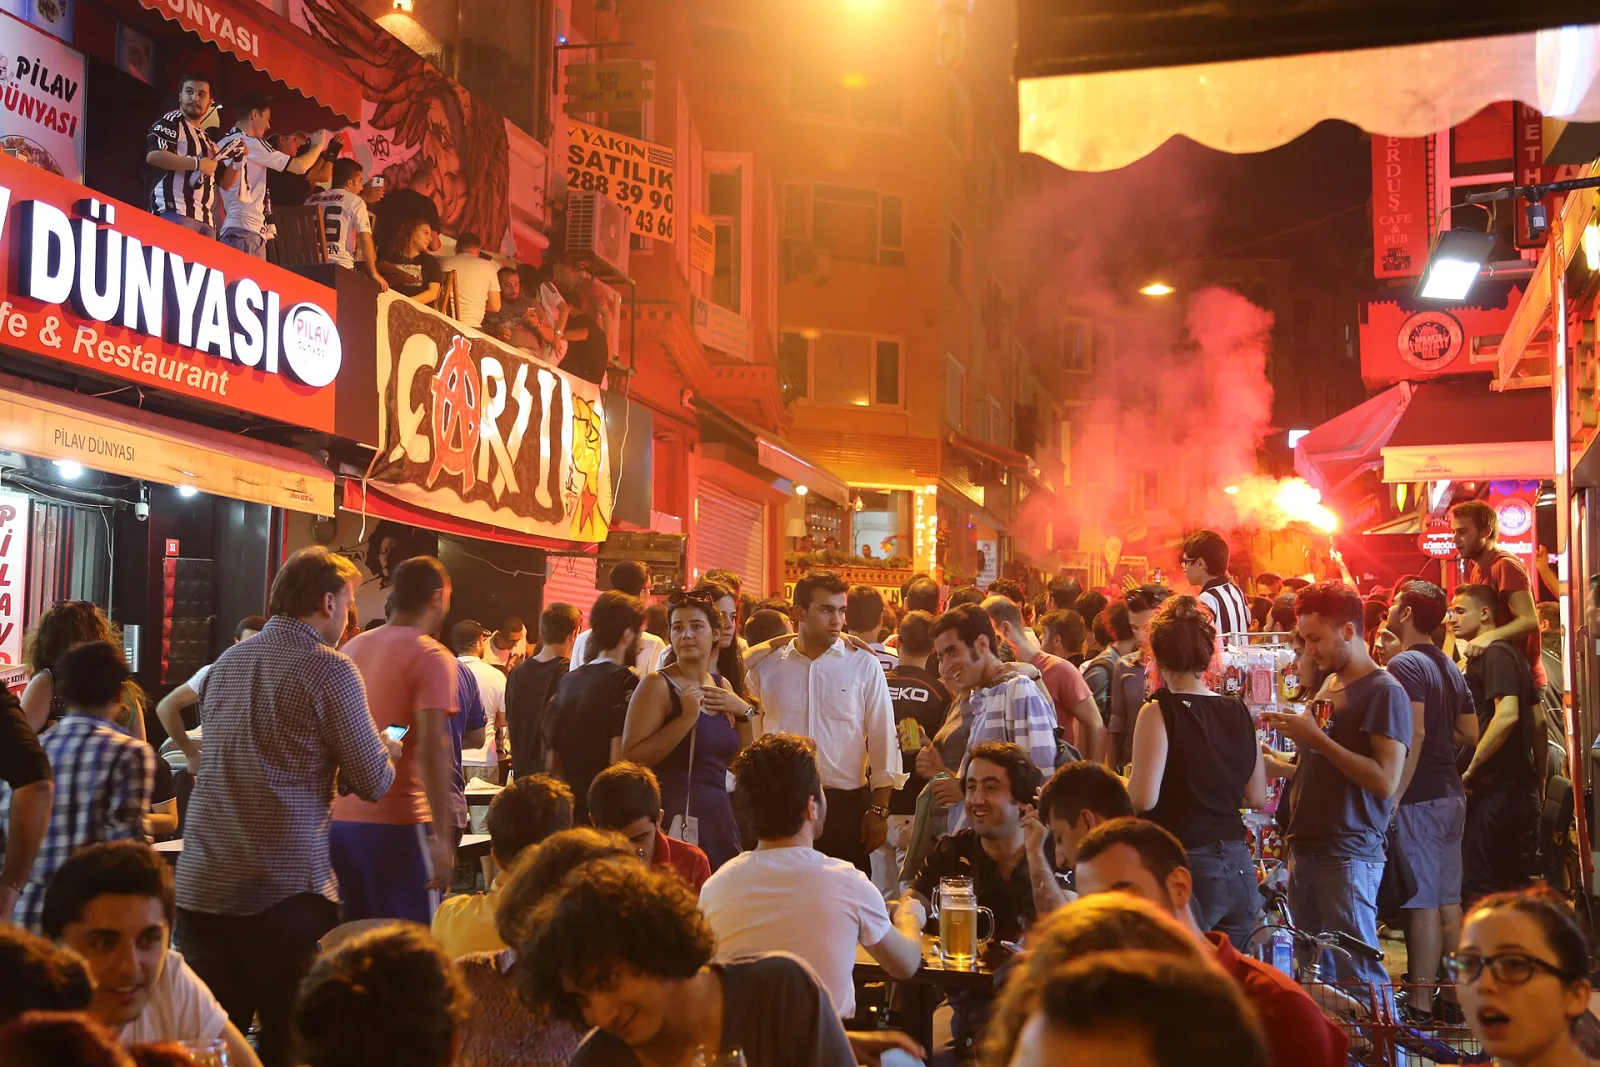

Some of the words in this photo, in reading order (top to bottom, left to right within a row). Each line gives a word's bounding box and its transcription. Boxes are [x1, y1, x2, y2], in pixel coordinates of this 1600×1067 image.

[16, 56, 78, 103] PİLAV
[154, 124, 177, 139] avea
[580, 128, 646, 160] YAKIN
[567, 144, 673, 192] SATILIK
[566, 166, 609, 195] 288
[615, 180, 643, 205] 39
[649, 189, 673, 214] 90
[635, 209, 654, 233] 43
[657, 215, 672, 239] 66
[1379, 213, 1412, 225] CAFE
[1390, 224, 1401, 234] &
[1383, 233, 1408, 245] PUB
[29, 197, 281, 375] DÜNYASI
[39, 315, 62, 349] &
[72, 324, 230, 397] Restaurant
[54, 427, 86, 450] PİLAV
[88, 436, 135, 462] DÜNYASI
[888, 686, 929, 703] EKO
